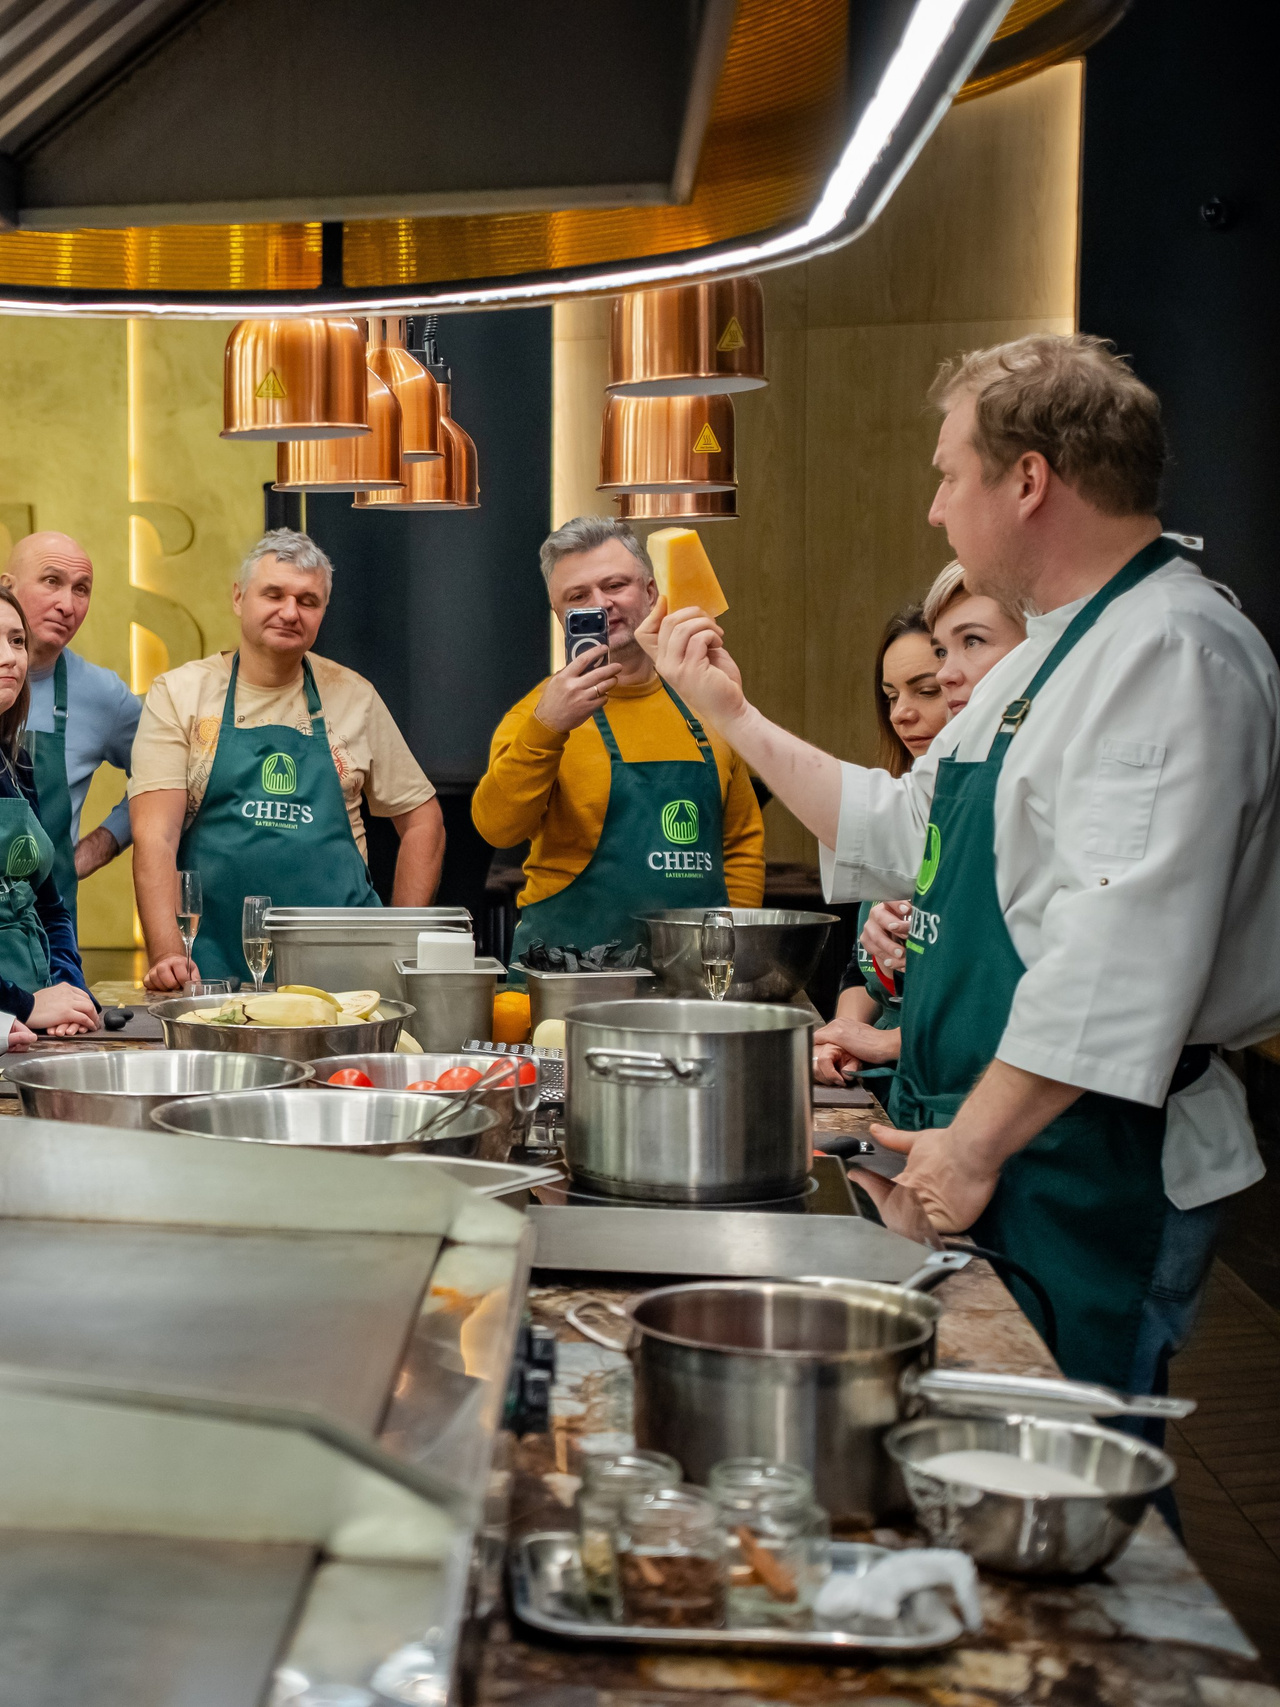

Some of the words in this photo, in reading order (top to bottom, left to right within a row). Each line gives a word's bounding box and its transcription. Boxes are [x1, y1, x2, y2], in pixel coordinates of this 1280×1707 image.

[241, 800, 314, 824] CHEFS
[648, 851, 713, 871] CHEFS
[907, 905, 940, 944] EFS
